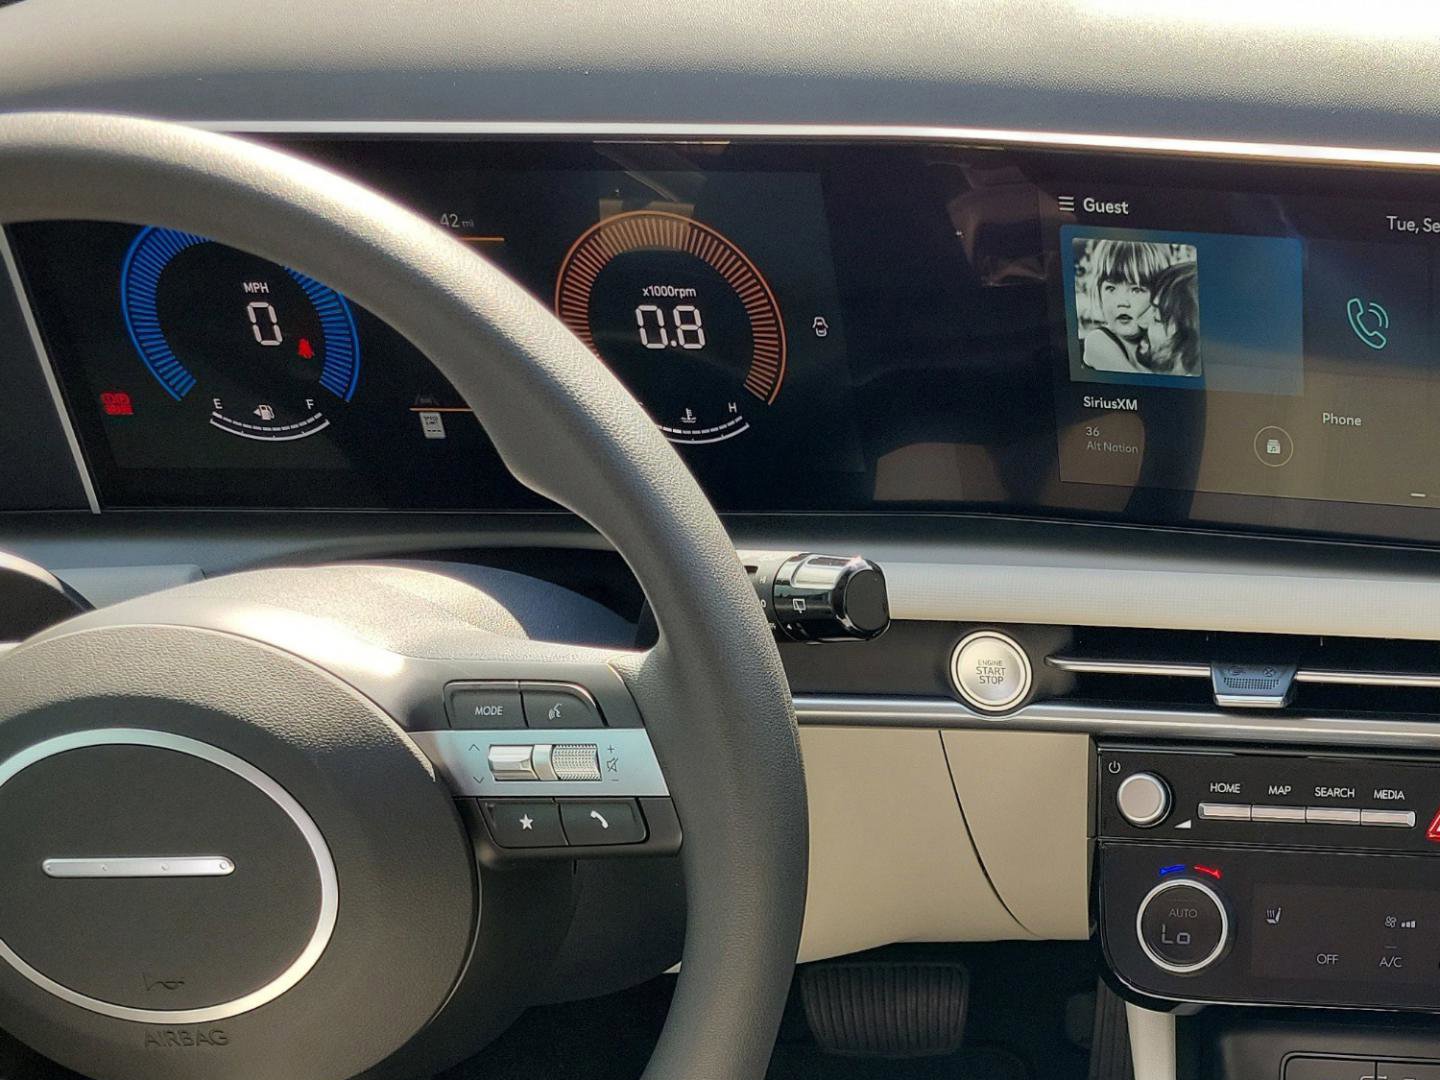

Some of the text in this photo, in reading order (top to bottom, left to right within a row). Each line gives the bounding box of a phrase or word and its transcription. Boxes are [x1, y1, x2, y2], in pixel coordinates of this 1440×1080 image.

[1083, 197, 1129, 215] Guest
[1386, 215, 1419, 235] Tue,
[243, 281, 270, 294] MPH
[642, 285, 697, 299] x1000rpm
[246, 301, 283, 347] 0
[635, 304, 707, 349] 0.8
[213, 398, 223, 410] E
[306, 398, 315, 410] F
[727, 402, 738, 413] H
[1083, 396, 1138, 411] SiriusXM
[1322, 412, 1362, 426] Phone
[1085, 427, 1100, 438] 36
[975, 667, 1006, 676] START
[979, 676, 1004, 685] STOP
[475, 705, 504, 716] MODE
[1210, 783, 1241, 794] HOME
[1268, 785, 1291, 796] MAP
[1314, 787, 1355, 799] SEARCH
[1373, 789, 1405, 801] MEDIA
[1168, 908, 1198, 919] AUTO
[1316, 953, 1339, 966] OFF
[1379, 956, 1402, 969] A/C
[144, 1029, 230, 1048] AIRBAG
